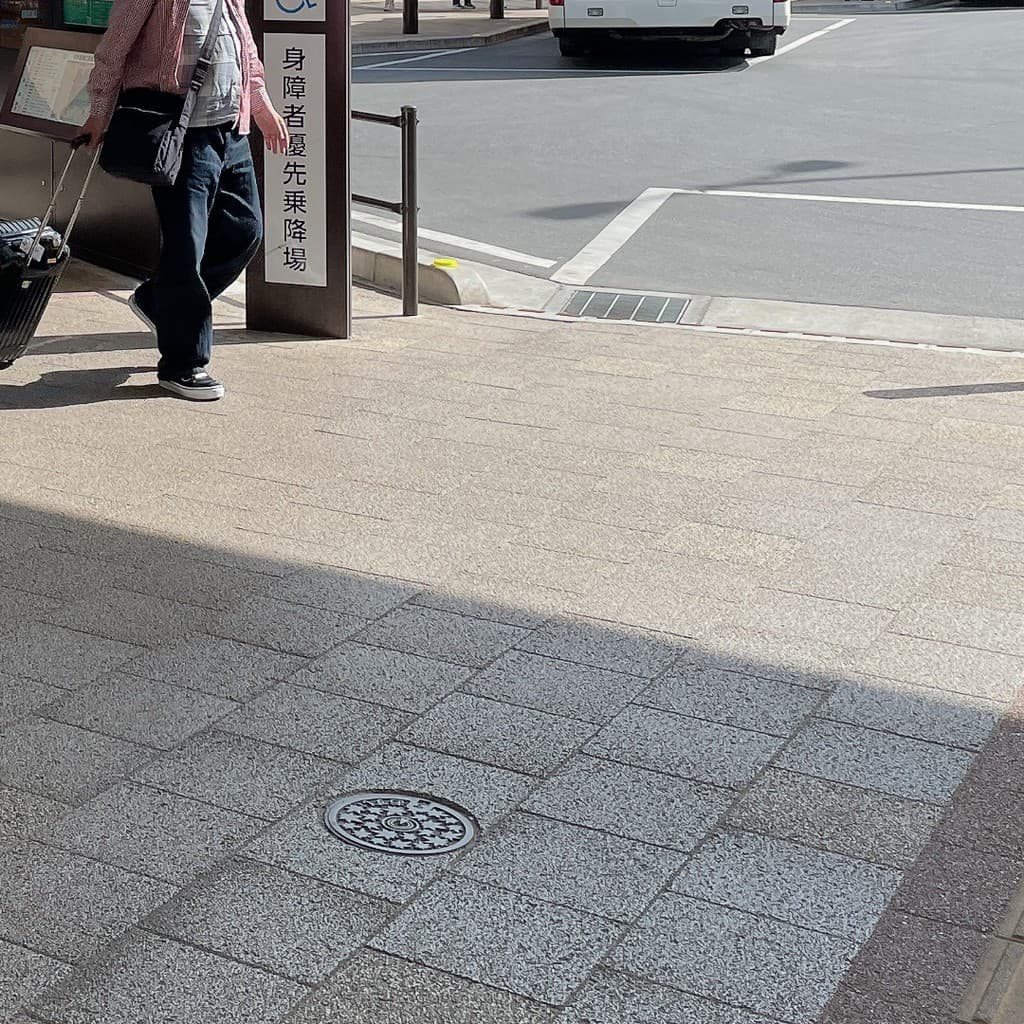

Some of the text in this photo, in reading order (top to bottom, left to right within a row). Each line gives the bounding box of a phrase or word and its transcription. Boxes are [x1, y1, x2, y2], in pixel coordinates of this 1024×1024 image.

[281, 46, 307, 273] 身障者優先乗降場
